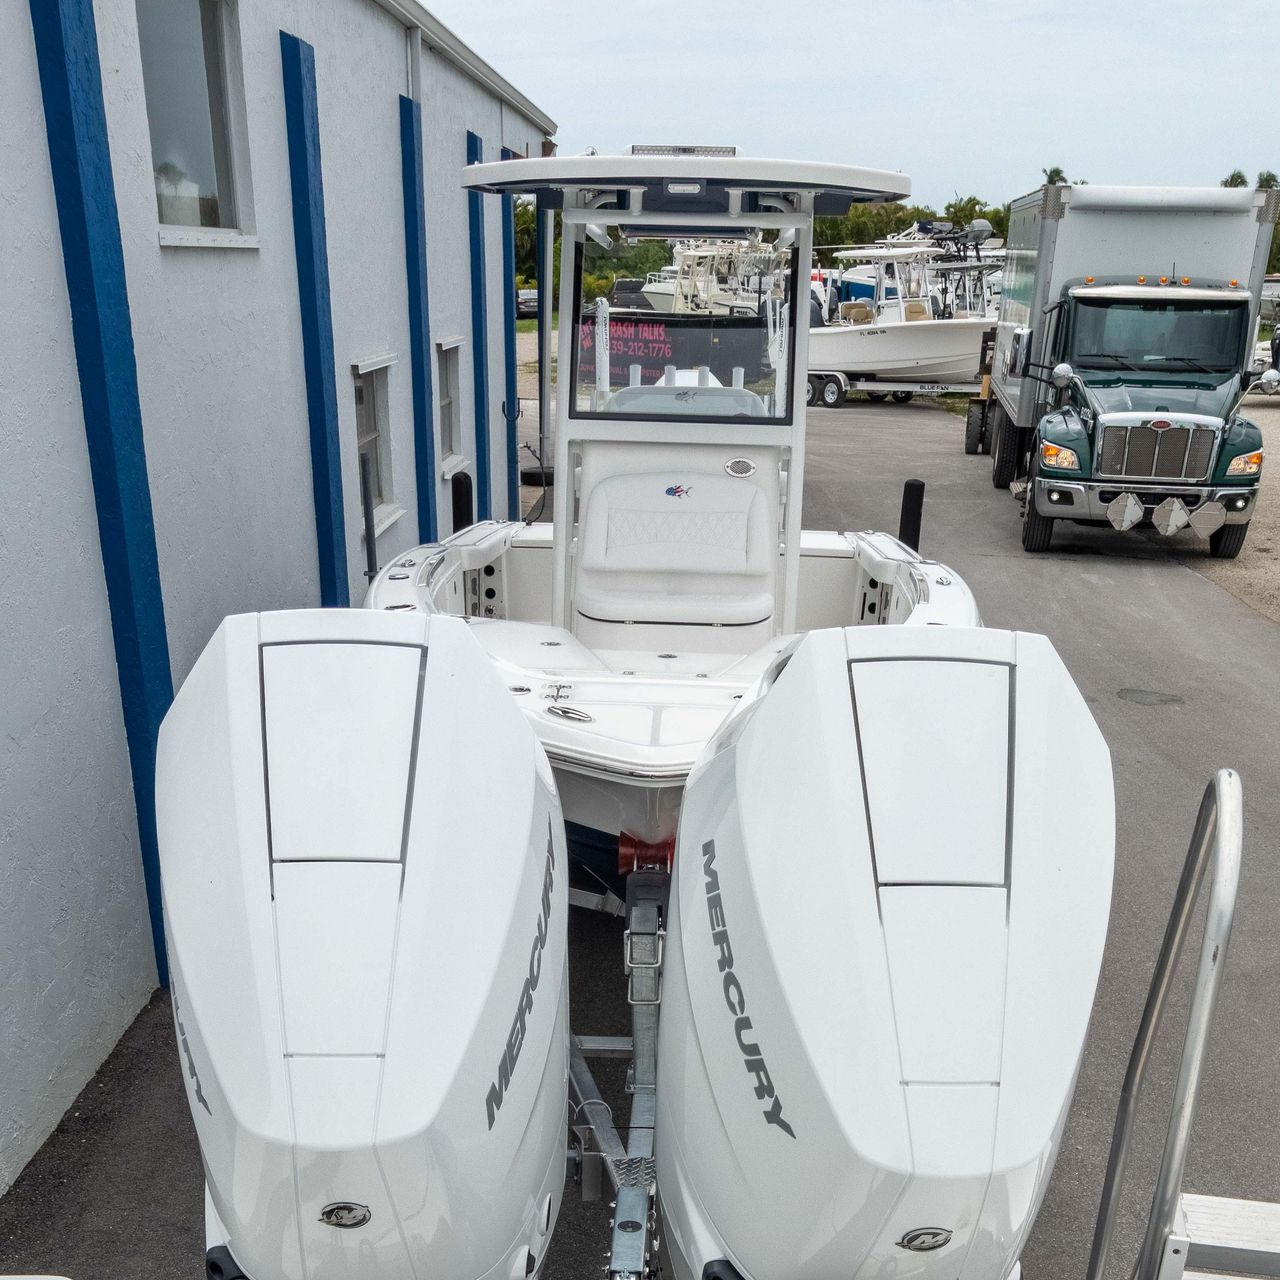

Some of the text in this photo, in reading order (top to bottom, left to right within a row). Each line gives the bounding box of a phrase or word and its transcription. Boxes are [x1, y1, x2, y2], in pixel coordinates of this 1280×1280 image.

[609, 322, 634, 339] RASH
[638, 323, 665, 340] TALKS
[609, 341, 672, 357] 39-212-1776
[702, 838, 797, 1140] MERCURY
